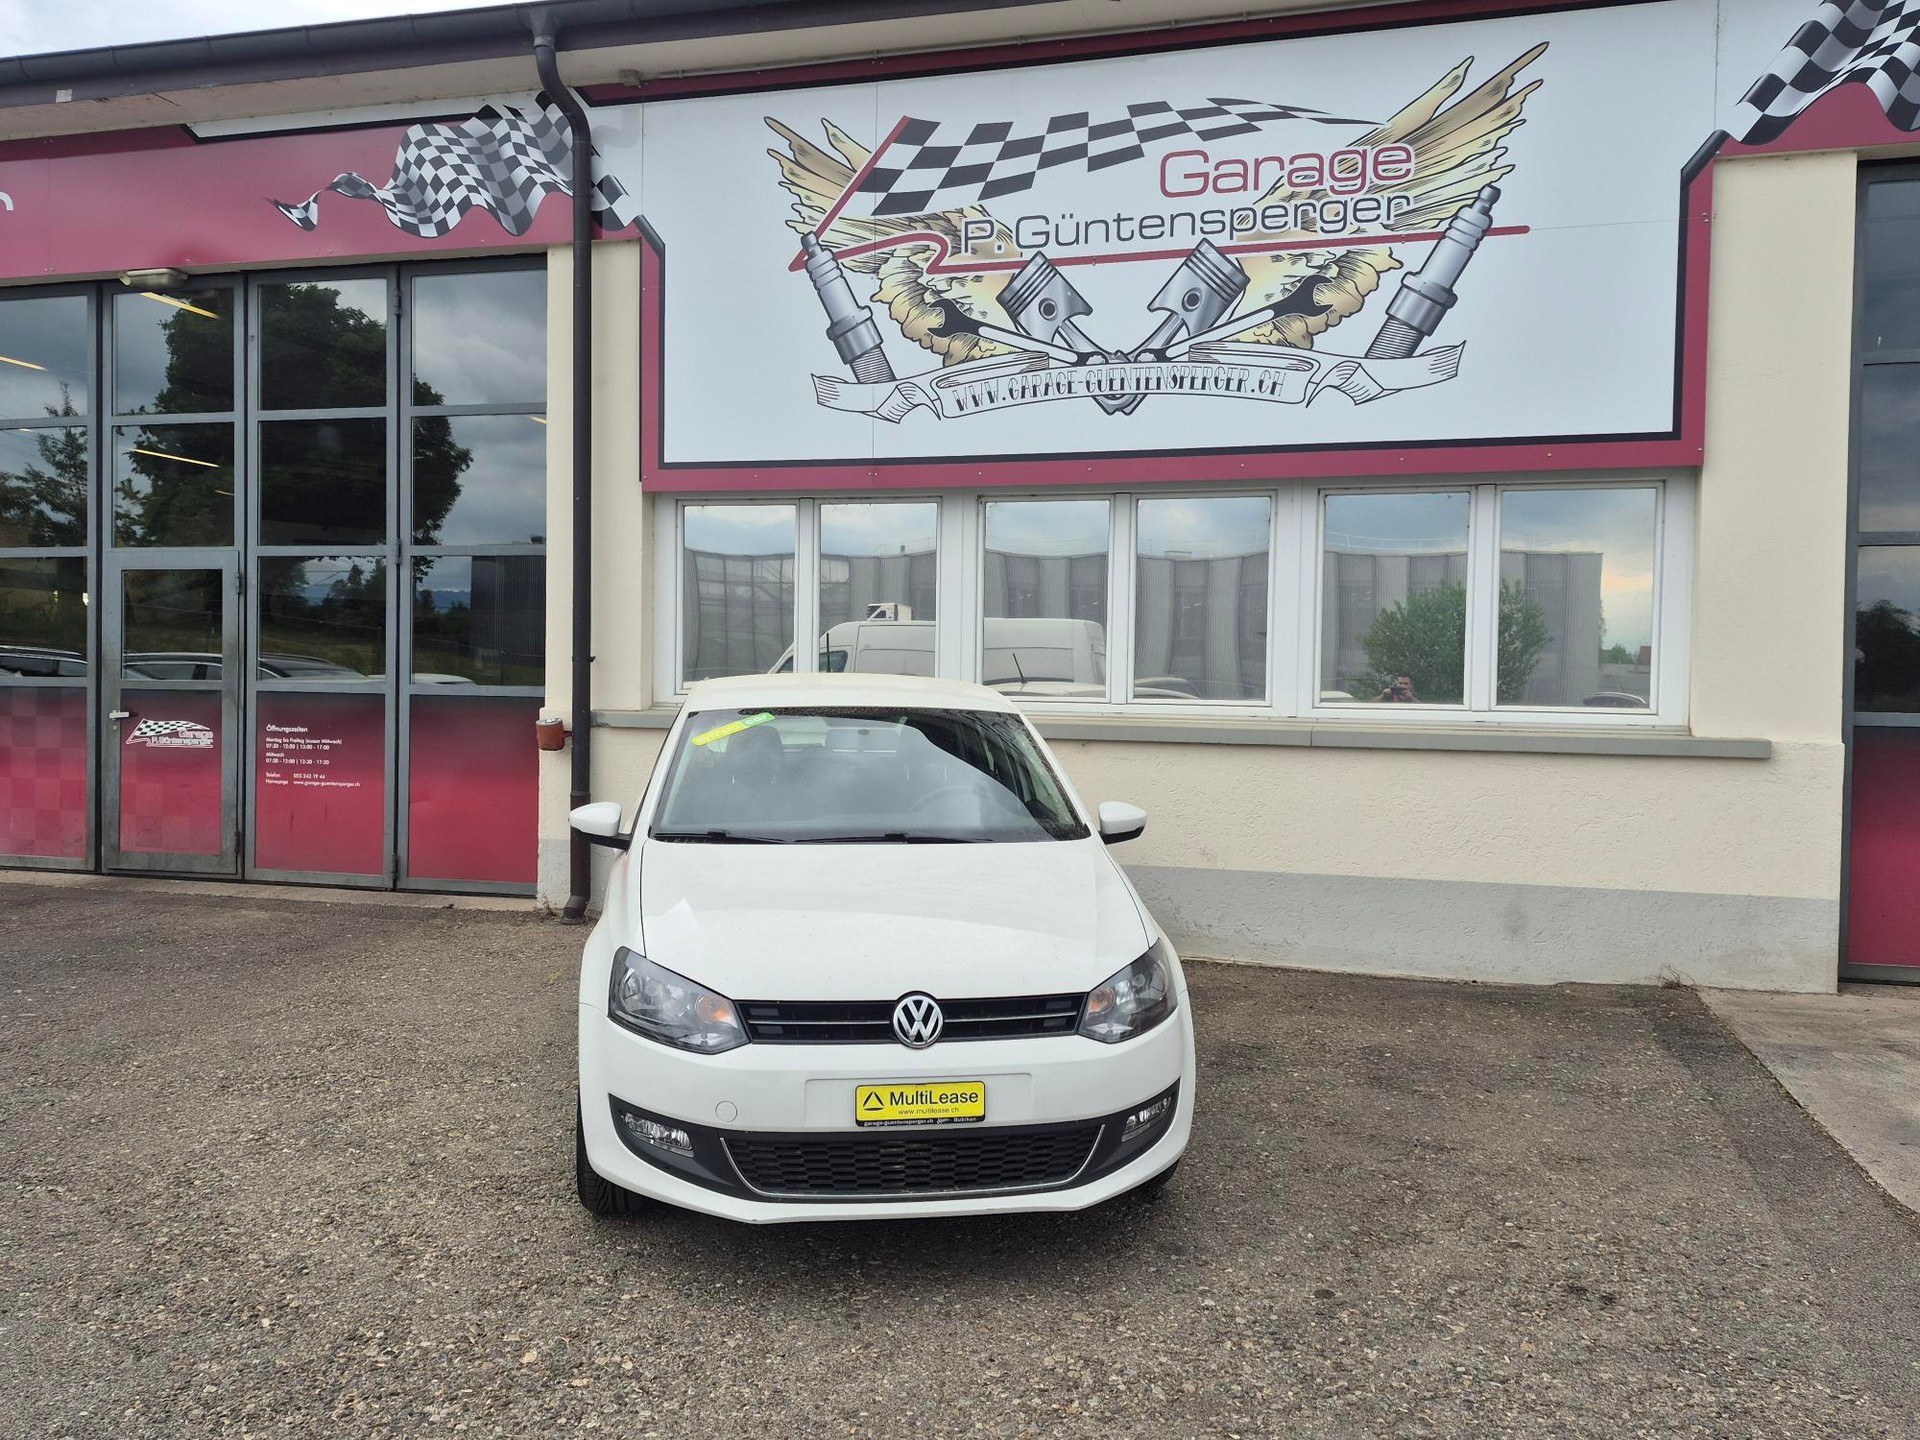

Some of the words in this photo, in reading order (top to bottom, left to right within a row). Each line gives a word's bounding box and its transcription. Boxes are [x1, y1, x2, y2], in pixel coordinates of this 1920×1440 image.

[1159, 144, 1412, 198] Garage
[962, 220, 1005, 254] P.
[1014, 193, 1411, 250] Güntensperger
[952, 366, 1287, 412] WWW.GARAGE-GUENTENSPERGER.CH
[266, 724, 308, 733] Öffnungszeiten
[889, 1090, 979, 1106] MultiLease
[898, 1107, 960, 1115] www.multilease.ch
